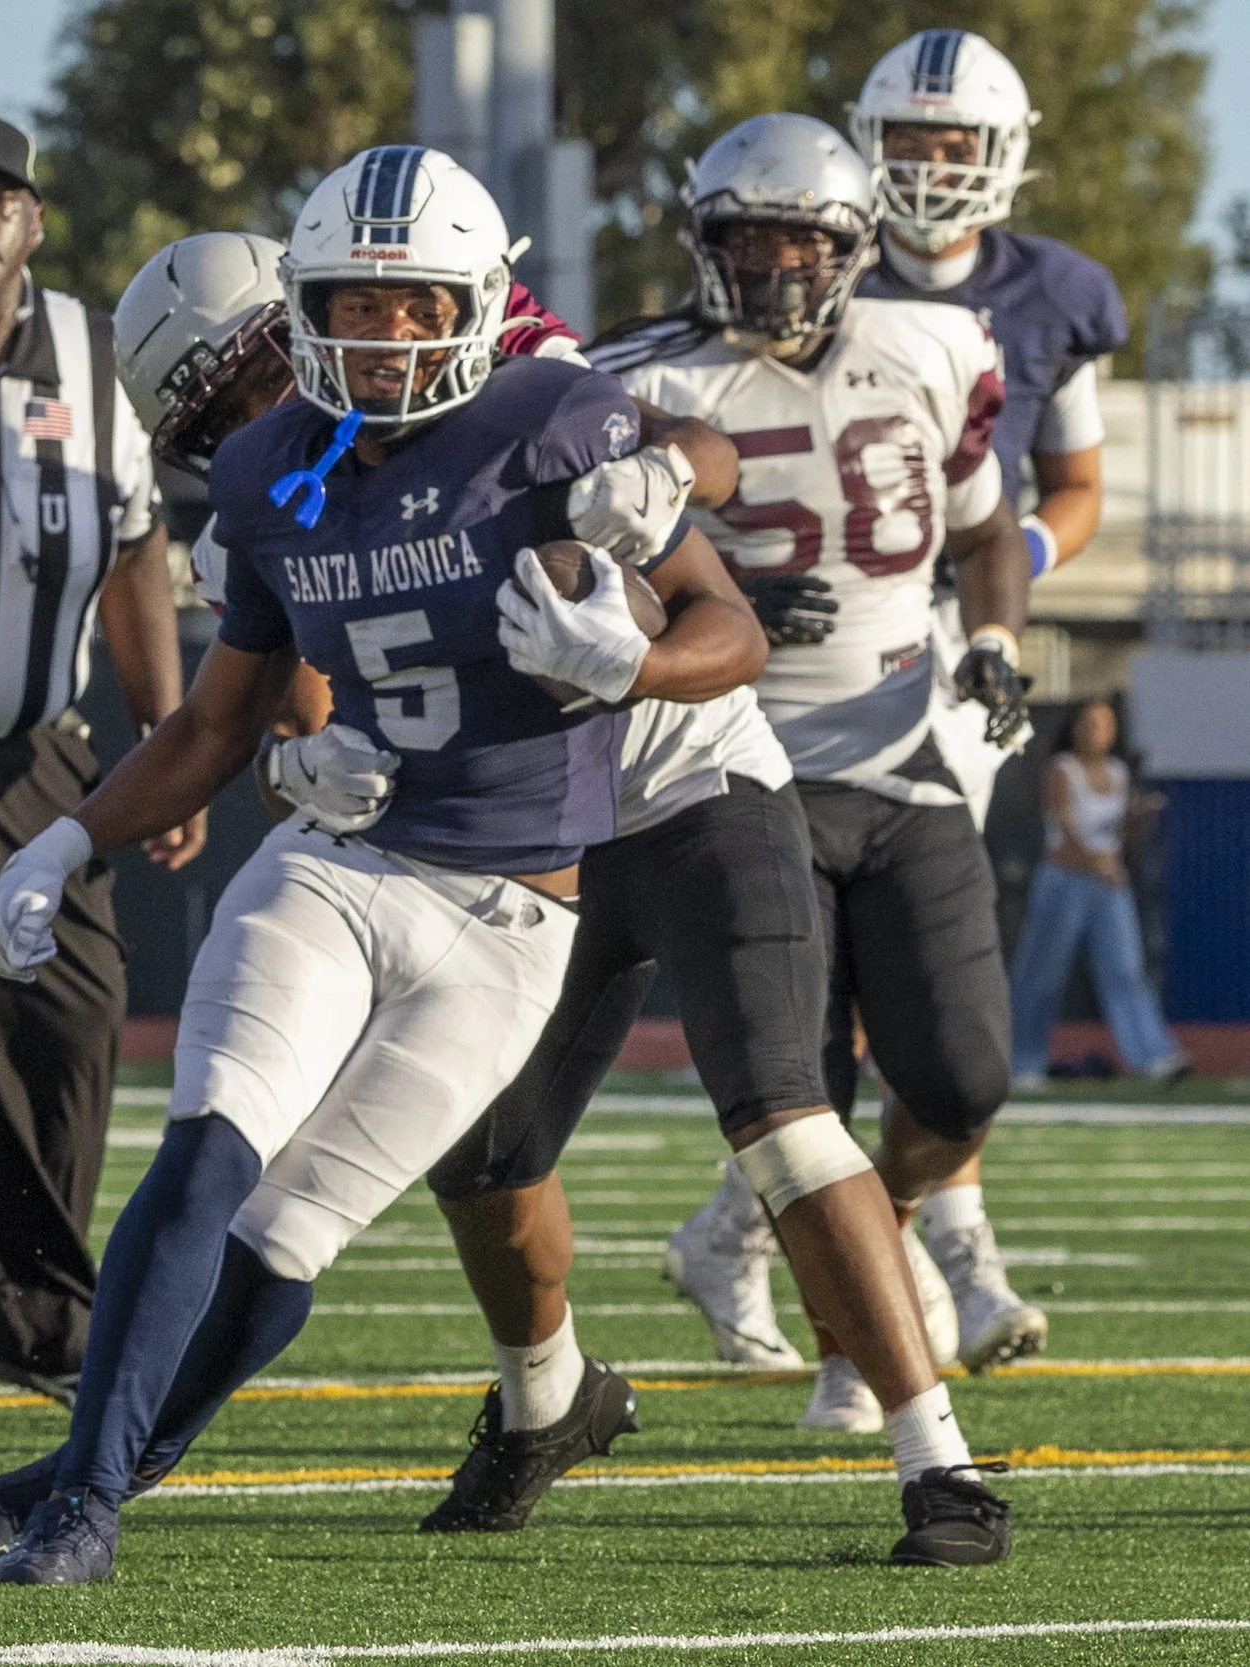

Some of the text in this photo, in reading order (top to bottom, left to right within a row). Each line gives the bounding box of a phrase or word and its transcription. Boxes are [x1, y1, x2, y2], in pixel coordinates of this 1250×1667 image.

[171, 363, 191, 387] F7
[41, 493, 67, 535] U
[717, 414, 933, 579] 58
[283, 529, 483, 602] SANTA MONICA
[344, 608, 461, 751] 5
